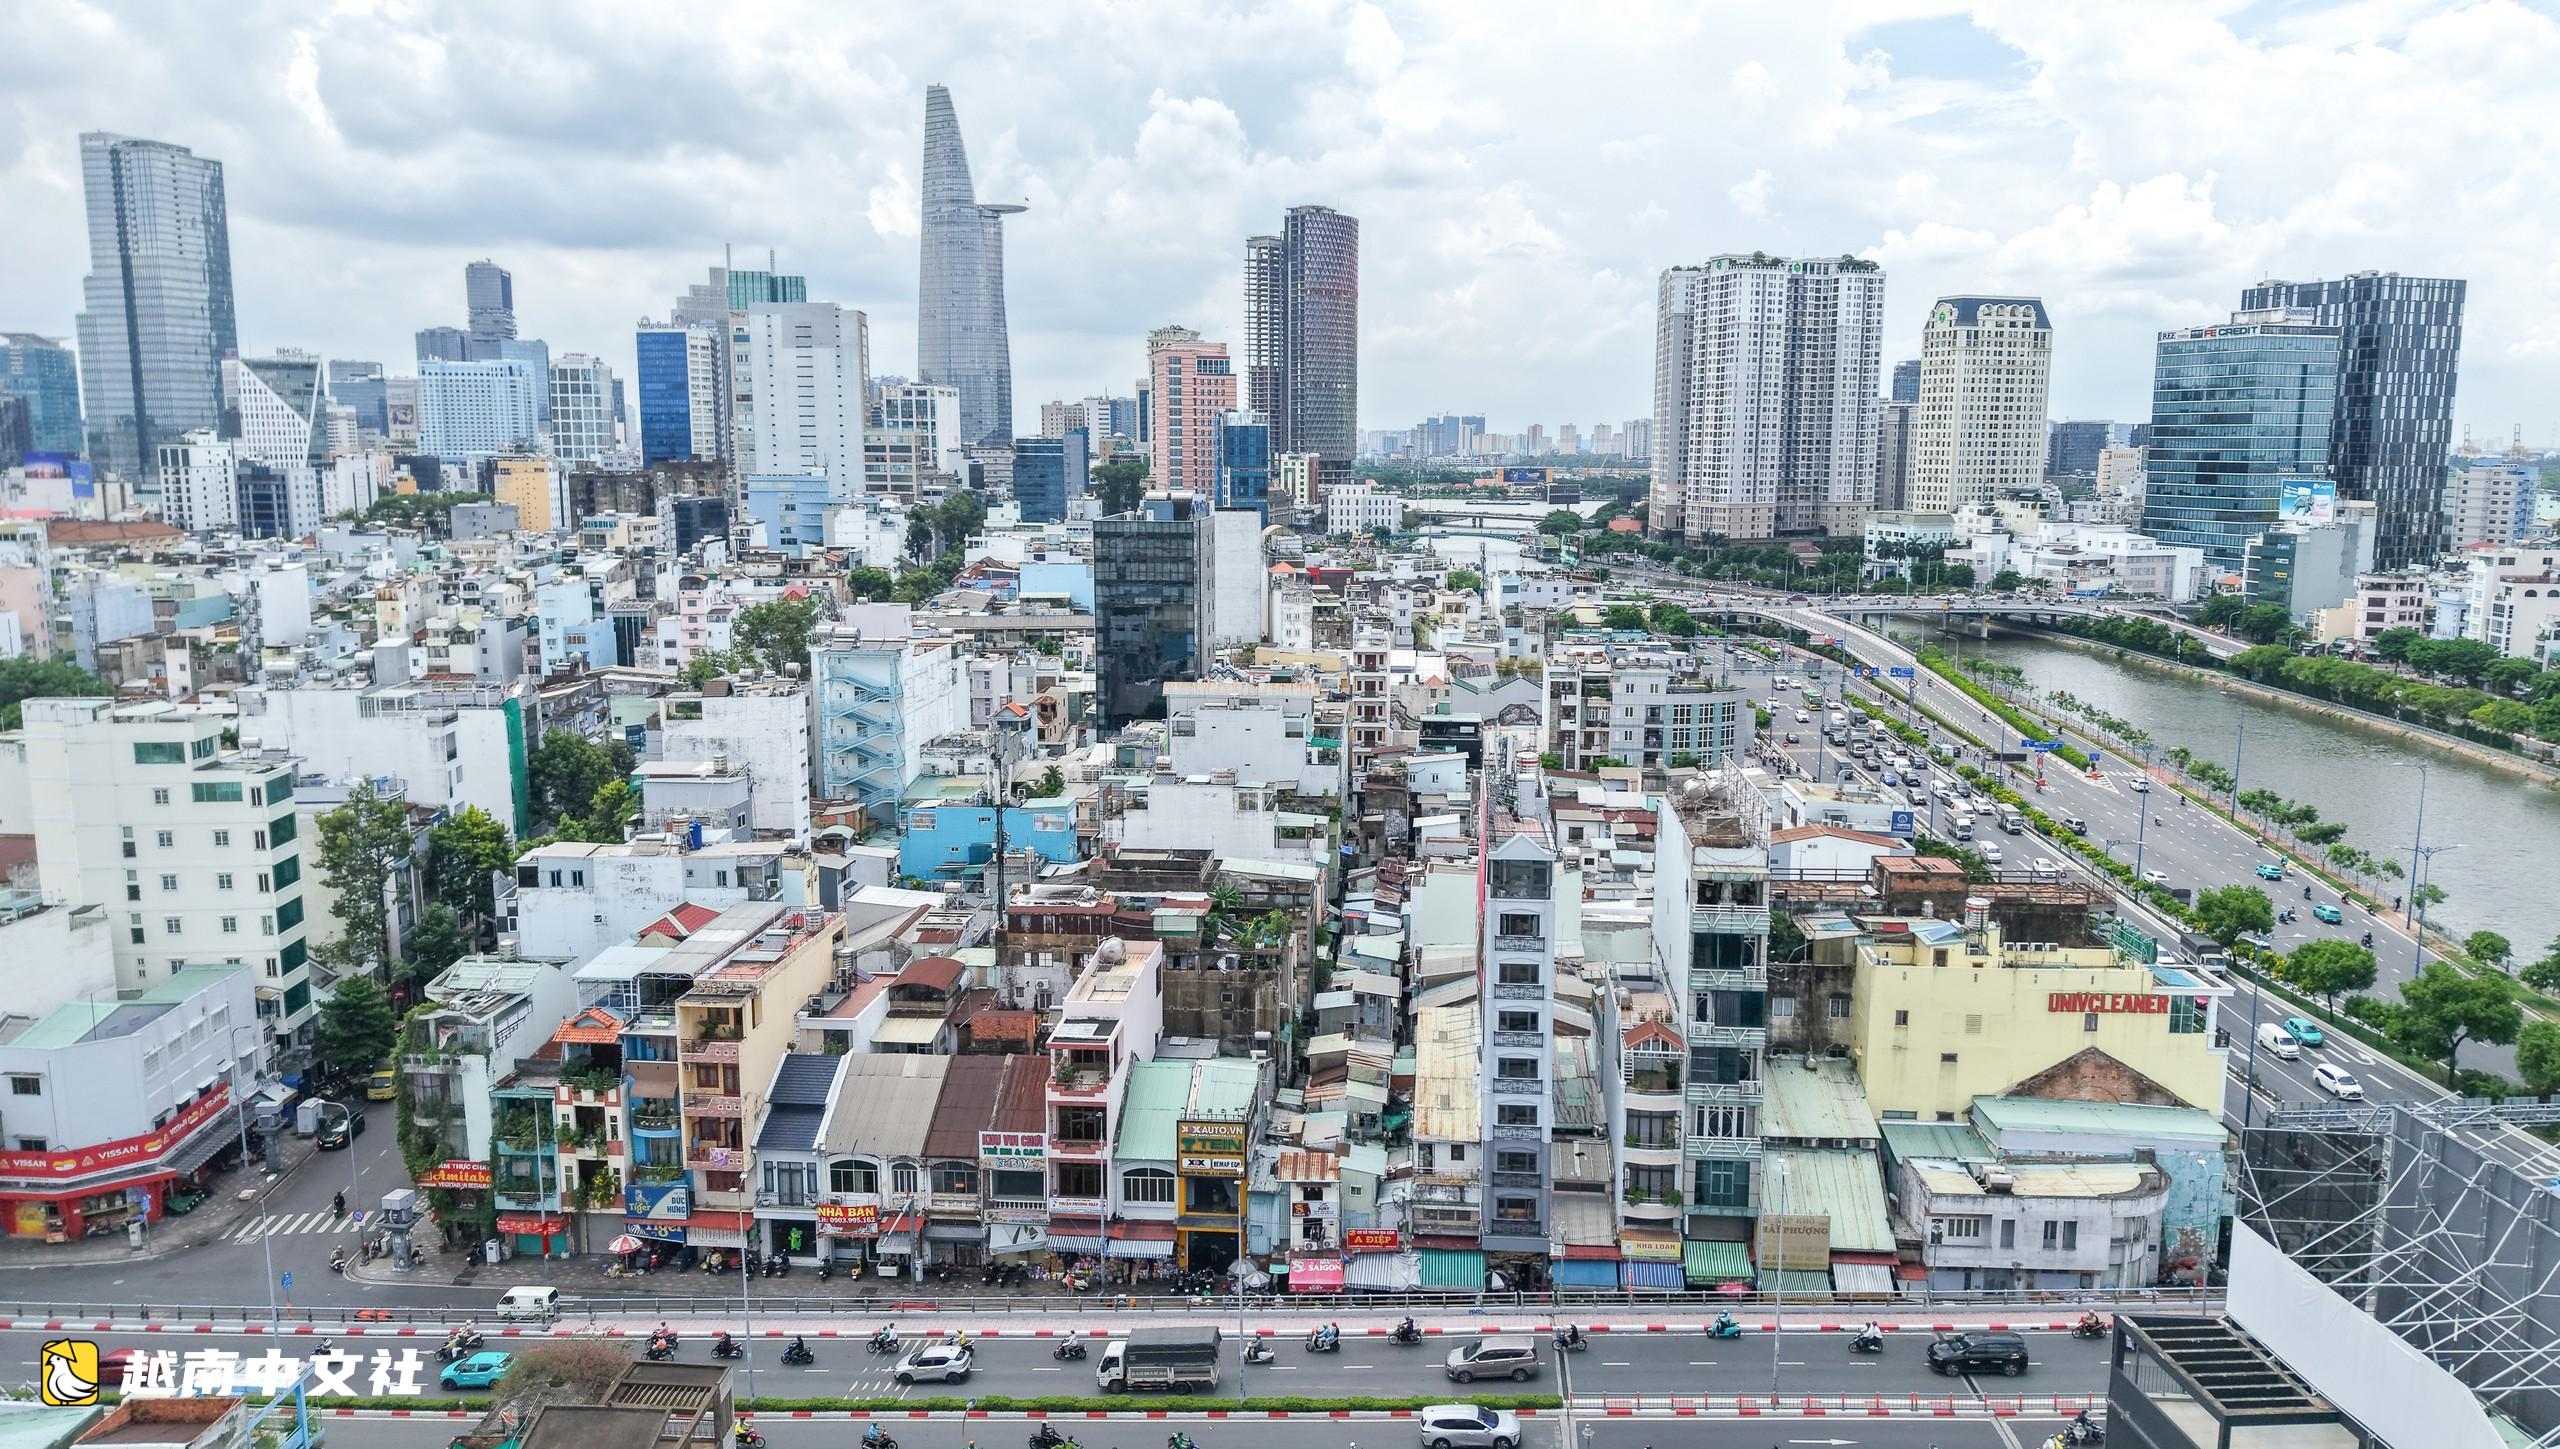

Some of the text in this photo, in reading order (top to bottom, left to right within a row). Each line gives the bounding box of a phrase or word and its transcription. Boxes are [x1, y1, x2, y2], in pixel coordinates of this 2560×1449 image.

[2204, 326, 2258, 337] FE CREDIT
[1003, 1134, 1019, 1147] VUI
[98, 1145, 139, 1160] VISSAN
[13, 1159, 47, 1168] VISSAN
[671, 1195, 686, 1204] ĐỨC
[629, 1202, 651, 1214] Tiger
[667, 1205, 686, 1213] HƯNG
[1365, 1234, 1392, 1246] ĐIỆP
[1308, 1264, 1342, 1272] SAIGON
